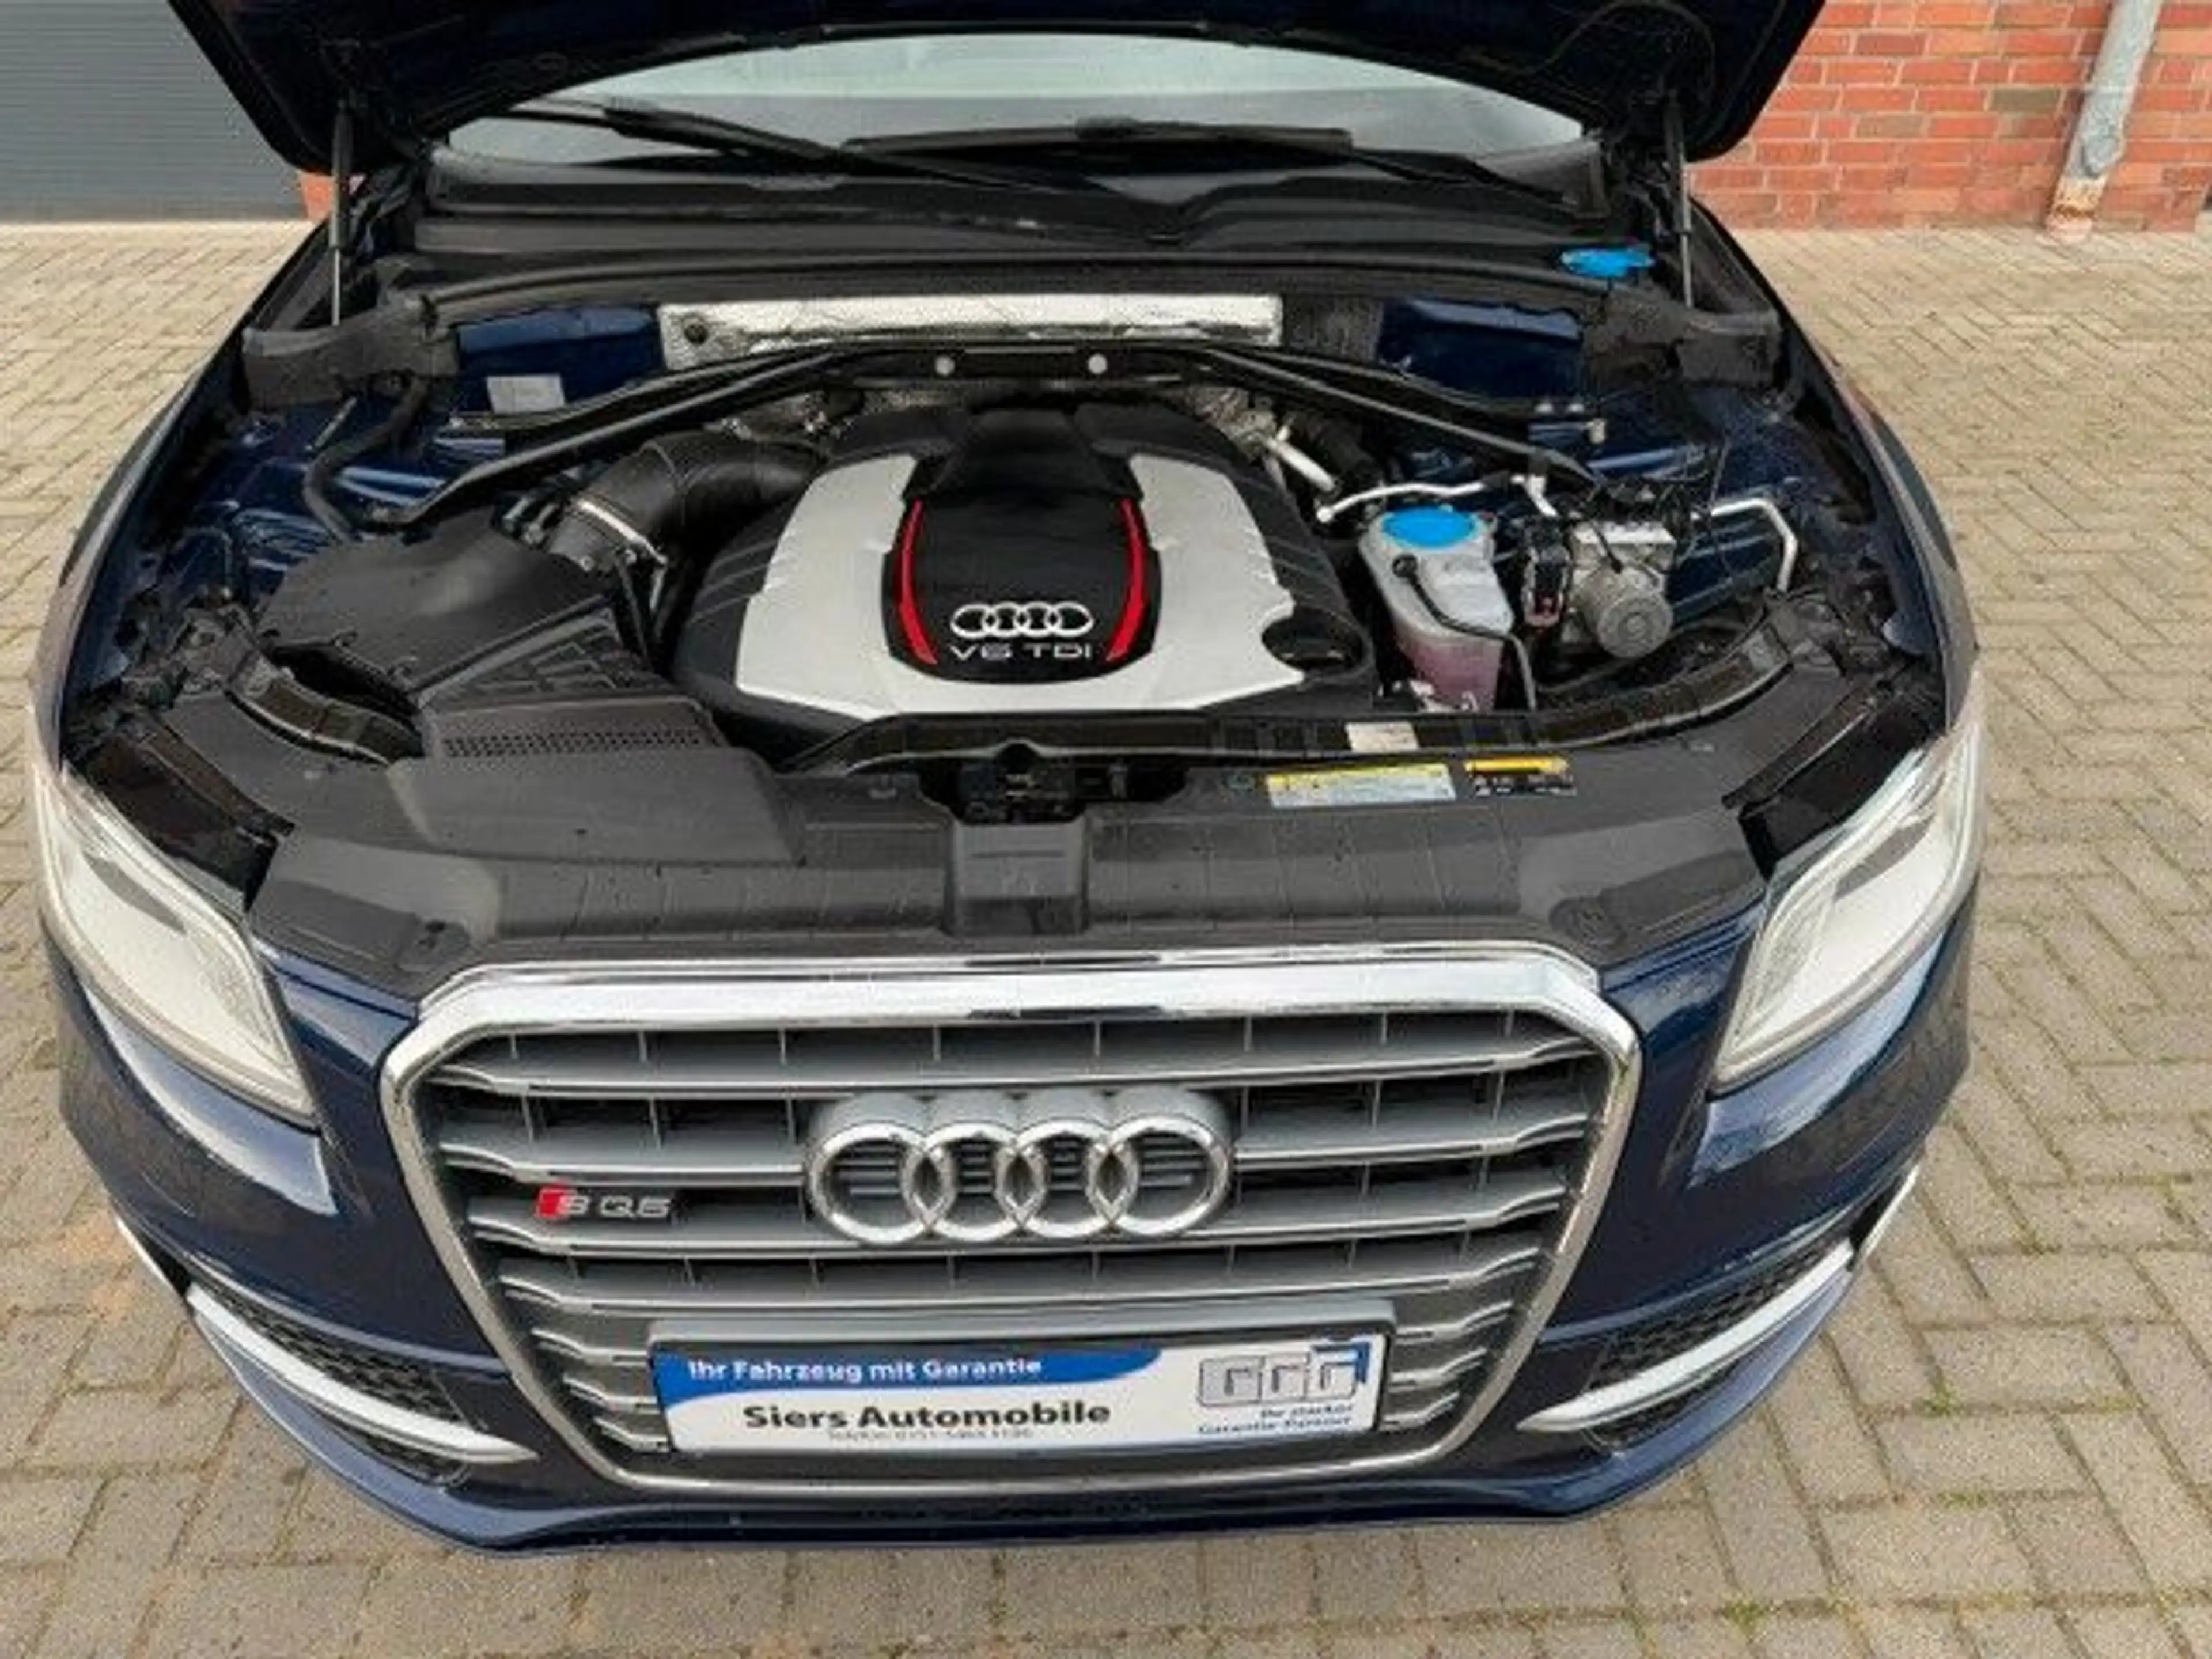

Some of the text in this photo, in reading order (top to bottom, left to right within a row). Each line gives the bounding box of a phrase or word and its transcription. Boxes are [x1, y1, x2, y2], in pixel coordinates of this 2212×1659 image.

[1023, 642, 1091, 659] TDI
[688, 1358, 1042, 1384] Ihr Fahrzeug mit Garantie
[743, 1400, 1111, 1428] Siers Automobile
